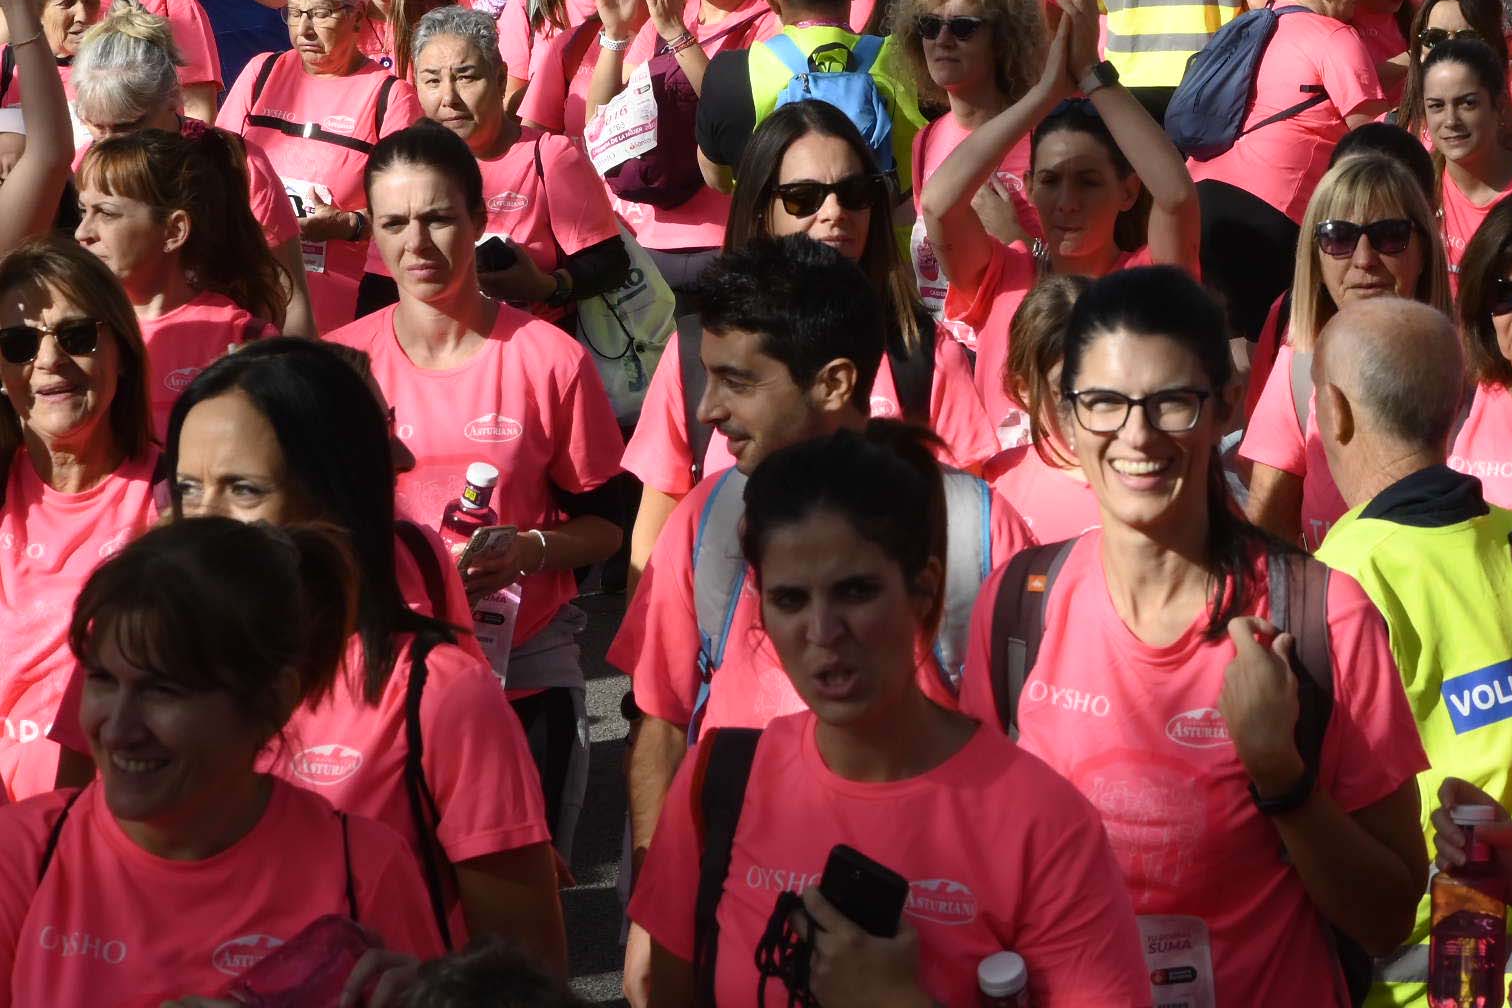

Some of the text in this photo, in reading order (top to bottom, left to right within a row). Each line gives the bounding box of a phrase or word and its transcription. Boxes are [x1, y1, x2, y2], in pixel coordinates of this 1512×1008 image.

[1026, 679, 1111, 717] OYSHO
[1171, 721, 1229, 738] ASTURIA
[1147, 940, 1192, 954] SUMA
